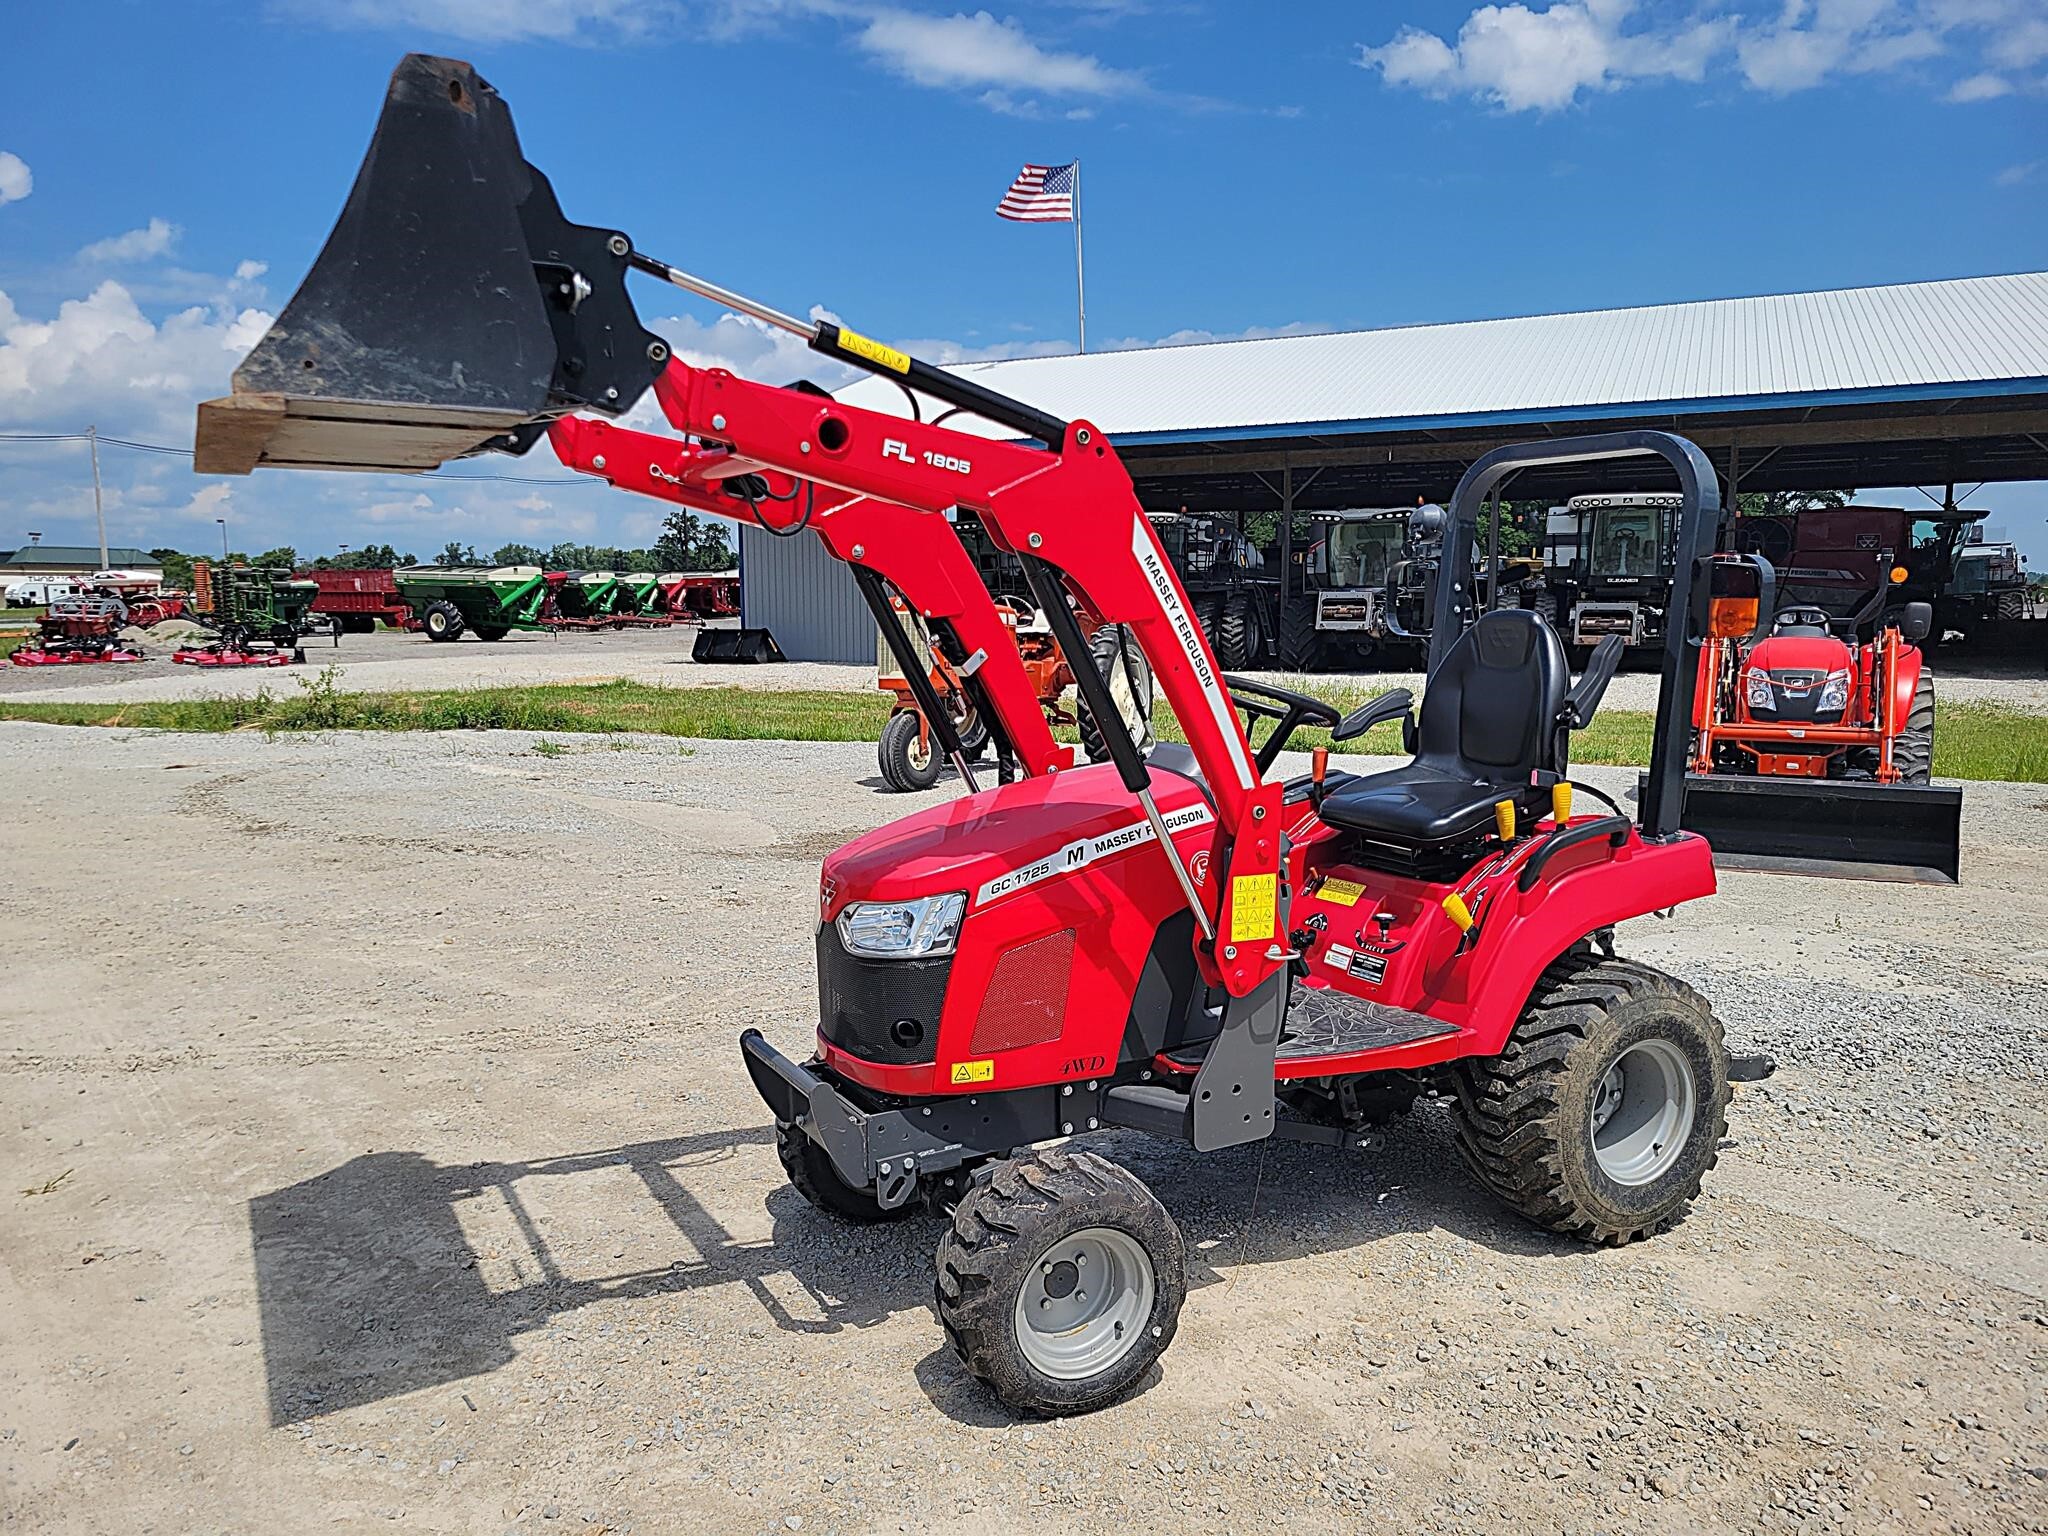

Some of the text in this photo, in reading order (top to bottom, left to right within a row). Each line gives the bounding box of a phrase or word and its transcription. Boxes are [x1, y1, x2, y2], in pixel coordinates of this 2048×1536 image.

[882, 438, 971, 474] FL 1805
[1144, 554, 1214, 688] MASSEY FERGUSON
[990, 809, 1204, 896] GC 1725 M MASSEY FGUSON
[1060, 1055, 1105, 1075] 4WD
